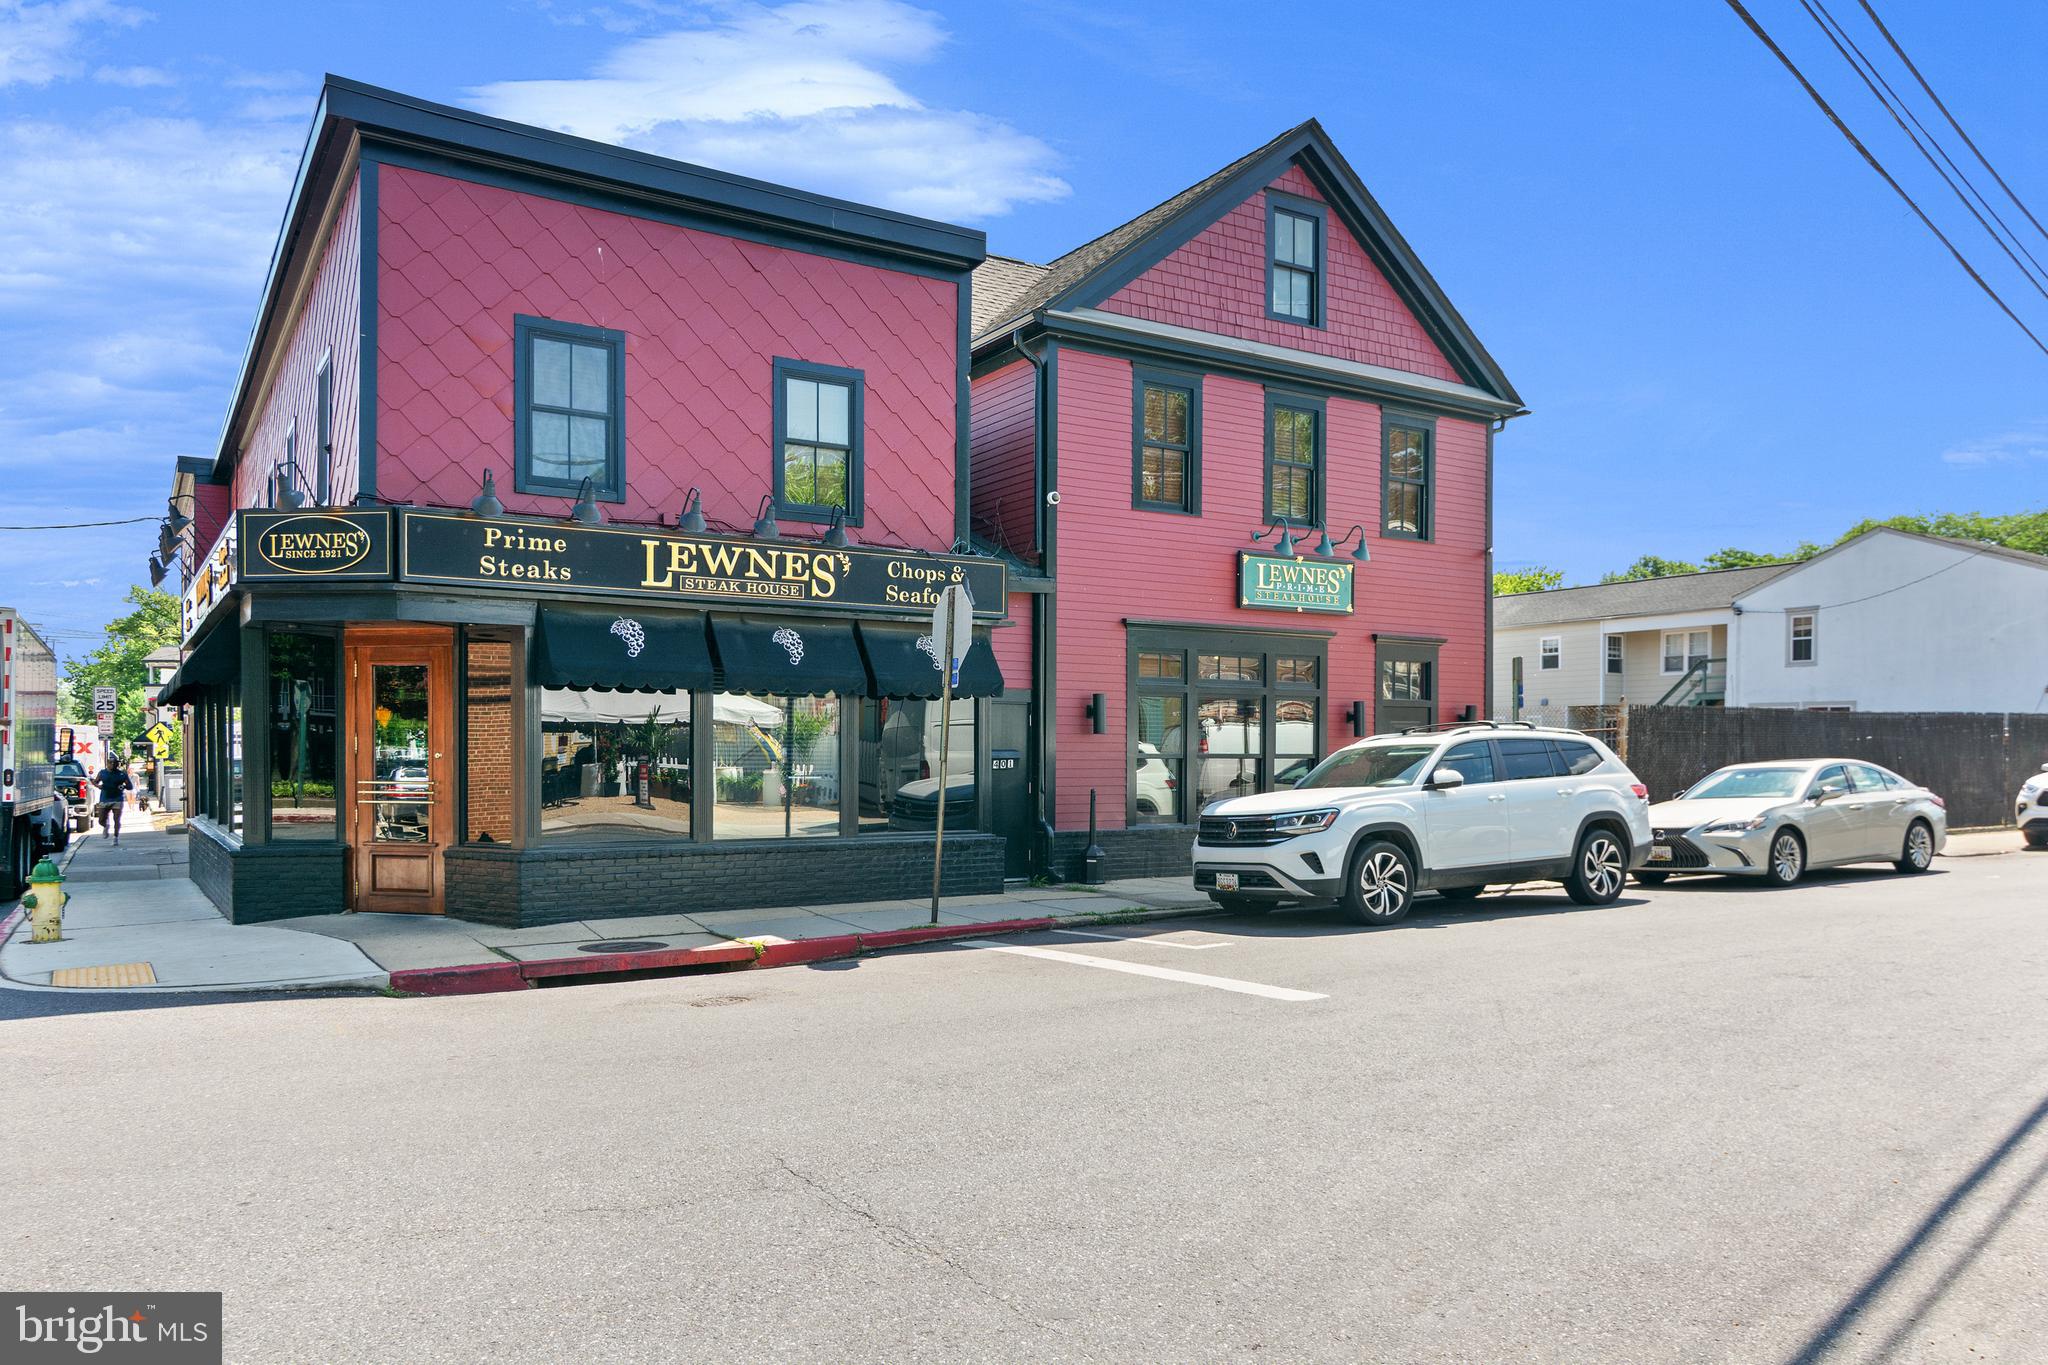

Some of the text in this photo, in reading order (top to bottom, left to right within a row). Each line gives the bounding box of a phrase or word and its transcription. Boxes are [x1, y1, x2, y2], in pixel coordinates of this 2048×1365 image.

[483, 527, 567, 553] Prime
[285, 549, 342, 559] SINCE 1921
[480, 555, 572, 581] Steaks
[887, 560, 965, 584] Chops &
[685, 579, 800, 597] STEAK HOUSE
[885, 584, 941, 605] Seafo
[1256, 591, 1340, 605] STEAKHOUSE
[95, 700, 116, 711] 25
[992, 759, 1014, 769] 401
